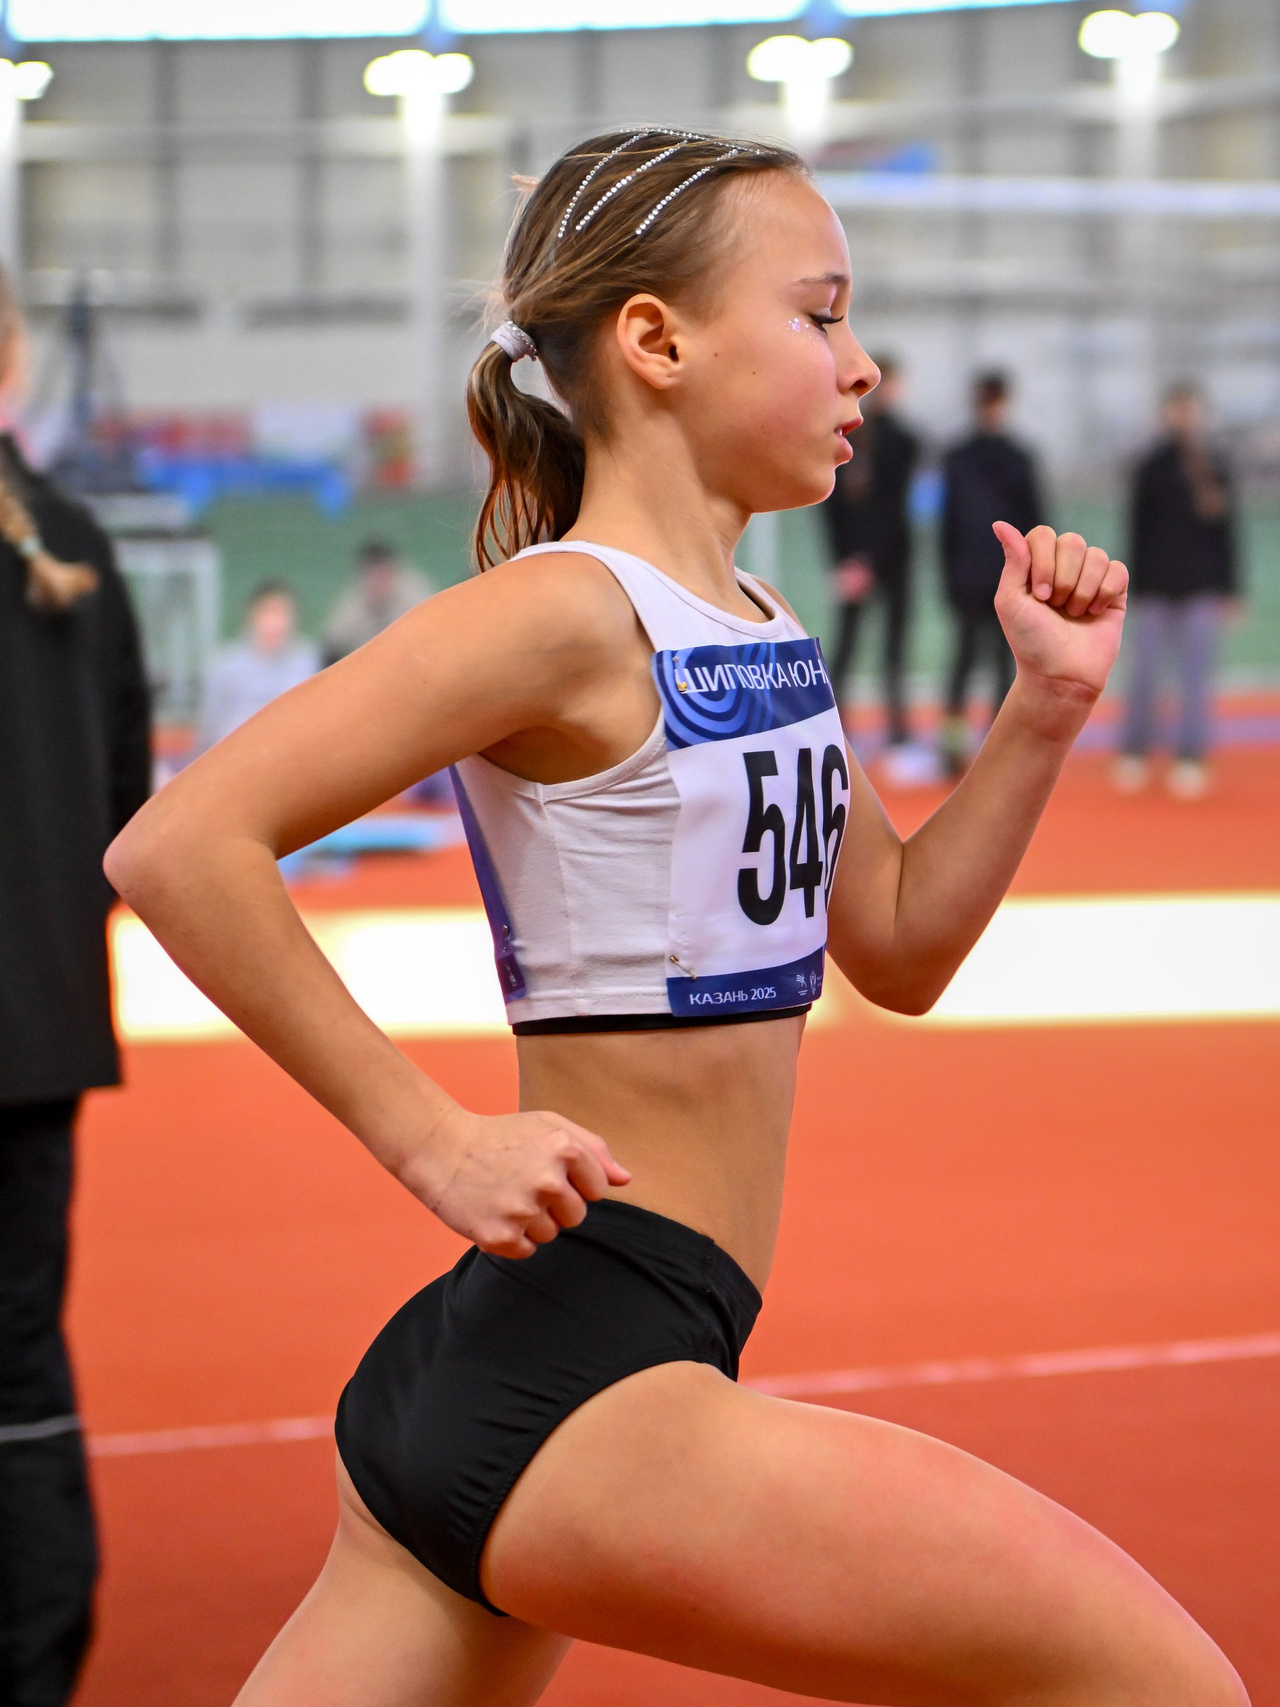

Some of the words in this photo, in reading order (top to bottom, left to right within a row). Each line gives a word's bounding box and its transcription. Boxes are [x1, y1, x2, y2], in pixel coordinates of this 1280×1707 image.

[674, 662, 791, 693] ШИПОВКА
[787, 659, 830, 688] ЮН
[737, 744, 849, 926] 546
[689, 990, 748, 1005] КАЗАНЬ
[750, 987, 777, 1001] 2025
